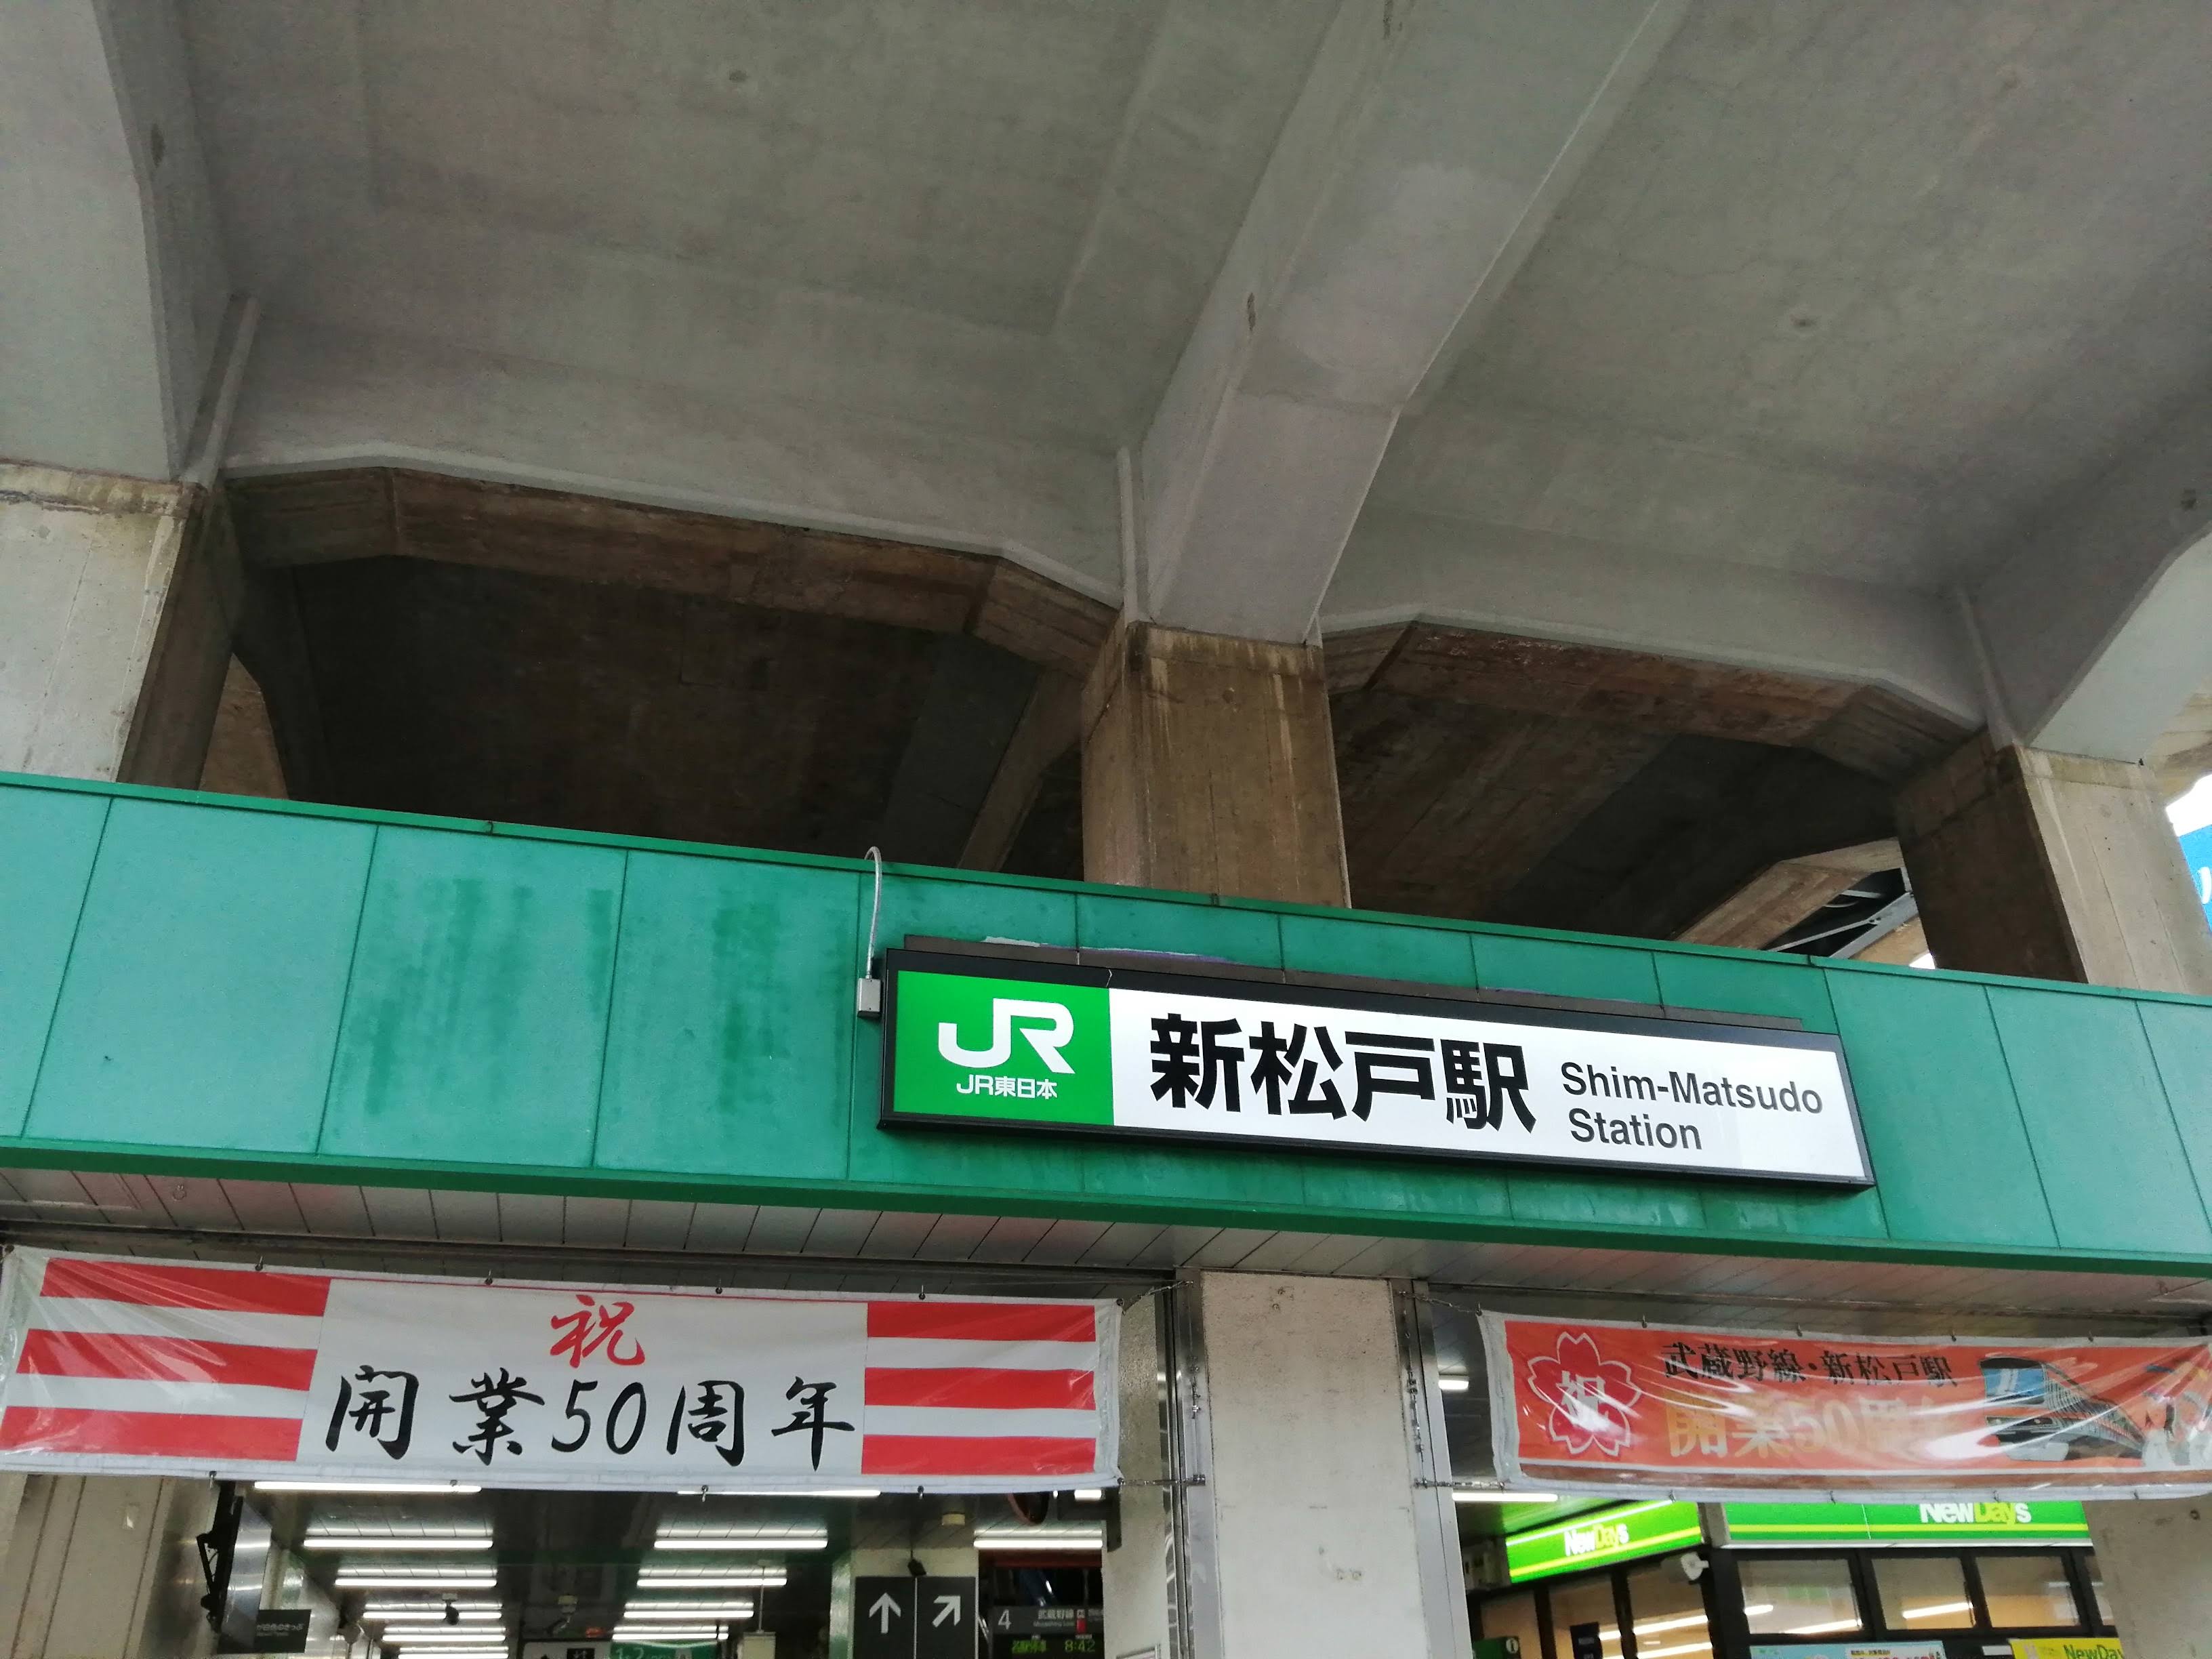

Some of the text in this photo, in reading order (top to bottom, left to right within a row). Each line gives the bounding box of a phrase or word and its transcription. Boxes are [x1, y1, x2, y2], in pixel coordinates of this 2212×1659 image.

[939, 998, 1076, 1073] JR
[956, 1074, 1058, 1099] JR東日本
[1150, 1013, 1536, 1133] 新松戸駅
[1561, 1062, 1823, 1113] Shim-Matsudo
[1568, 1108, 1702, 1149] Station
[550, 1294, 645, 1368] 祝
[325, 1365, 855, 1471] 開業50周年
[1919, 1502, 2032, 1525] NewDays
[1563, 1523, 1629, 1557] NewDays
[998, 1609, 1012, 1629] 4
